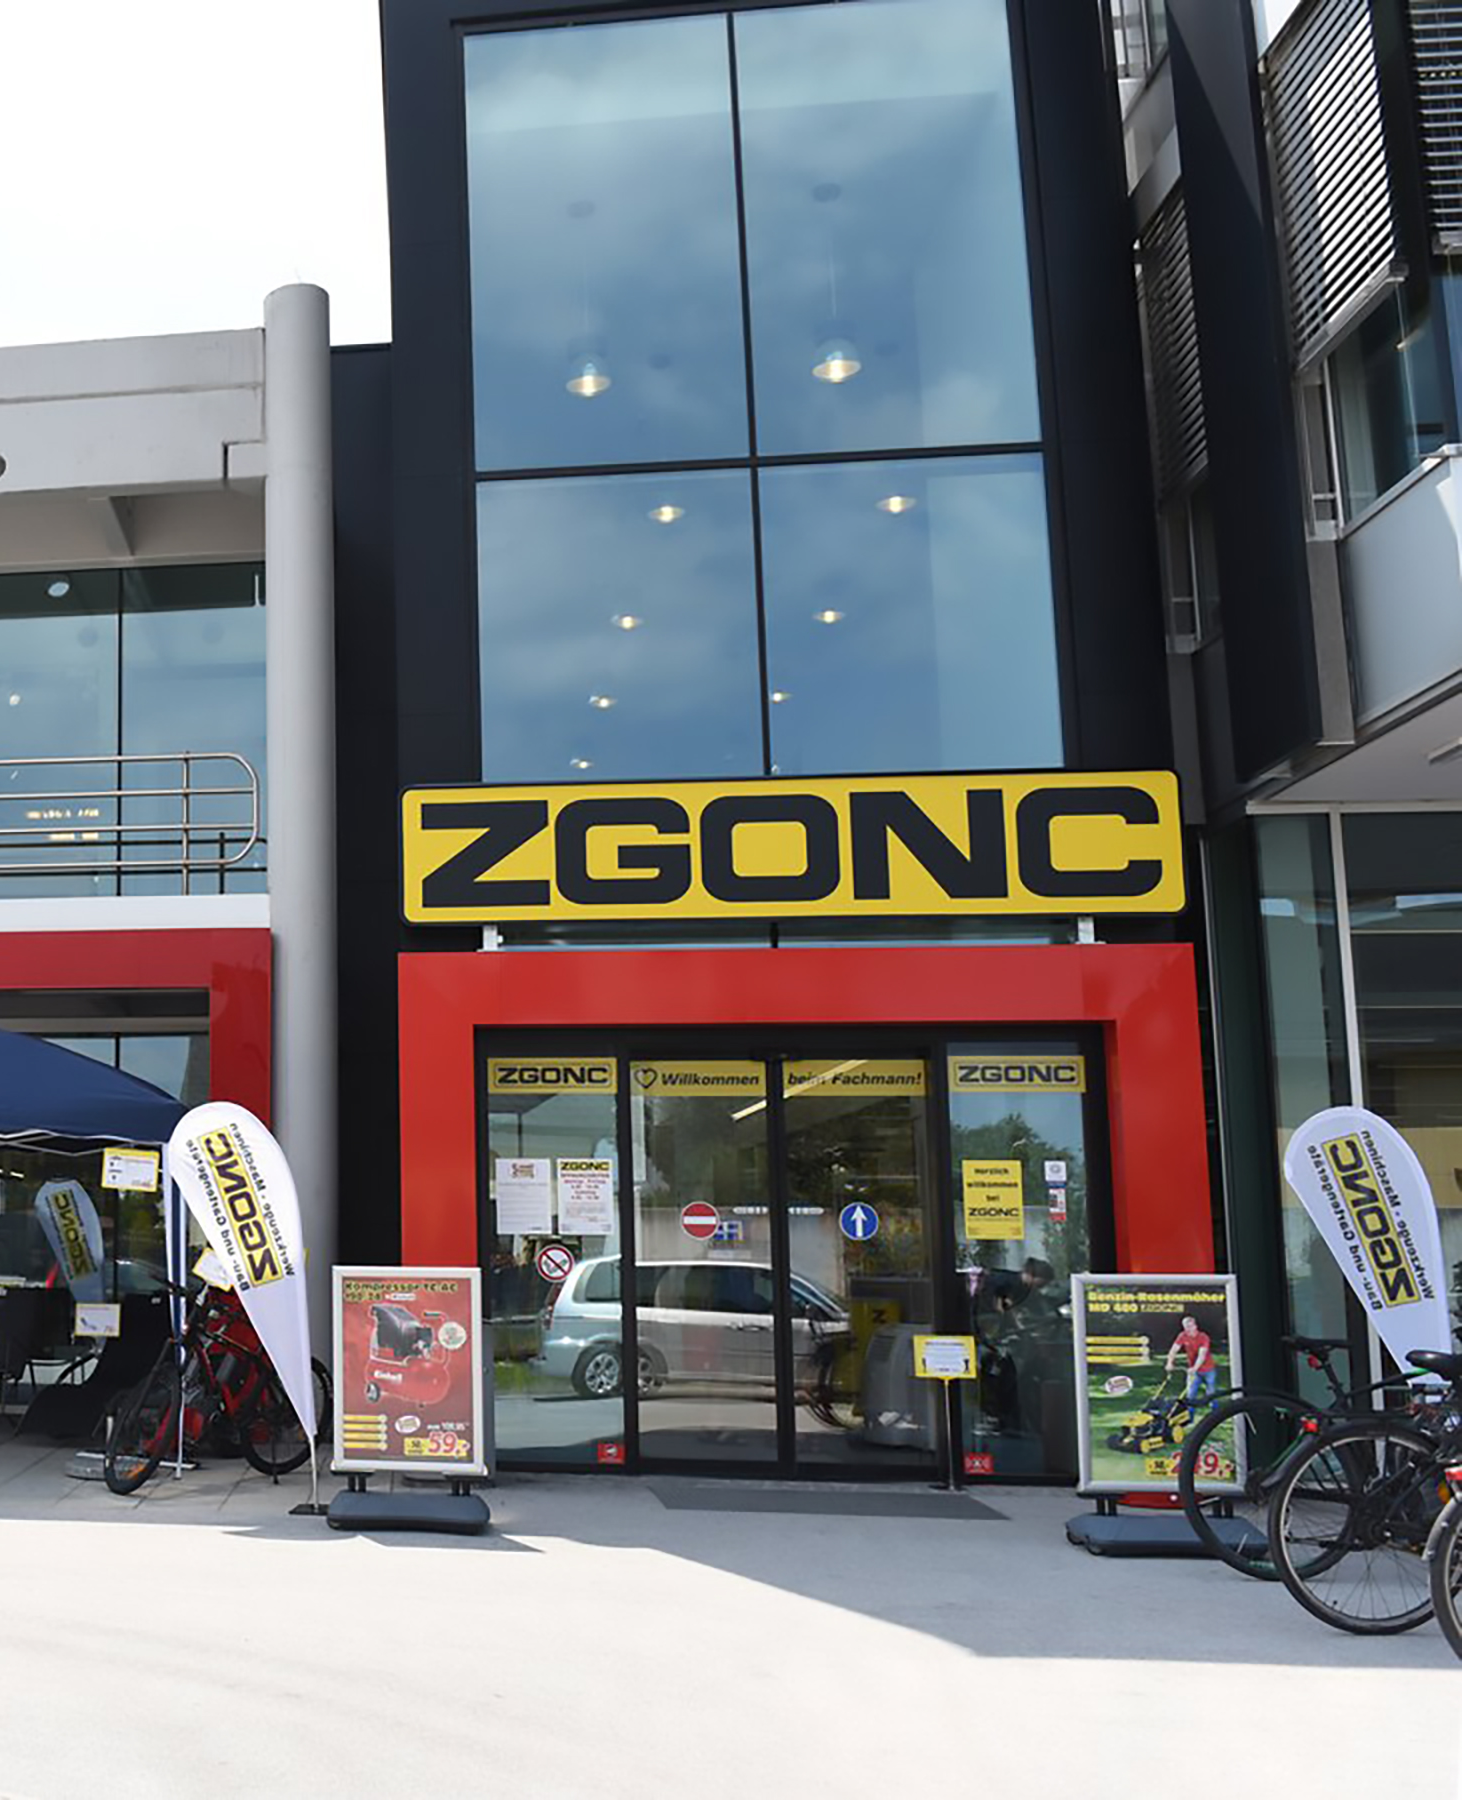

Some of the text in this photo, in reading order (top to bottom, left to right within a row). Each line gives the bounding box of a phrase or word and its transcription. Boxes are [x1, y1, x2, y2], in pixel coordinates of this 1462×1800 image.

[421, 786, 1163, 908] ZGONC
[497, 1067, 608, 1084] ZGONC
[661, 1073, 759, 1085] Willkommen
[831, 1072, 922, 1085] Fachmann!
[958, 1065, 1076, 1083] ZGONC
[561, 1161, 609, 1171] ZGONC
[969, 1208, 1019, 1216] ZGONC
